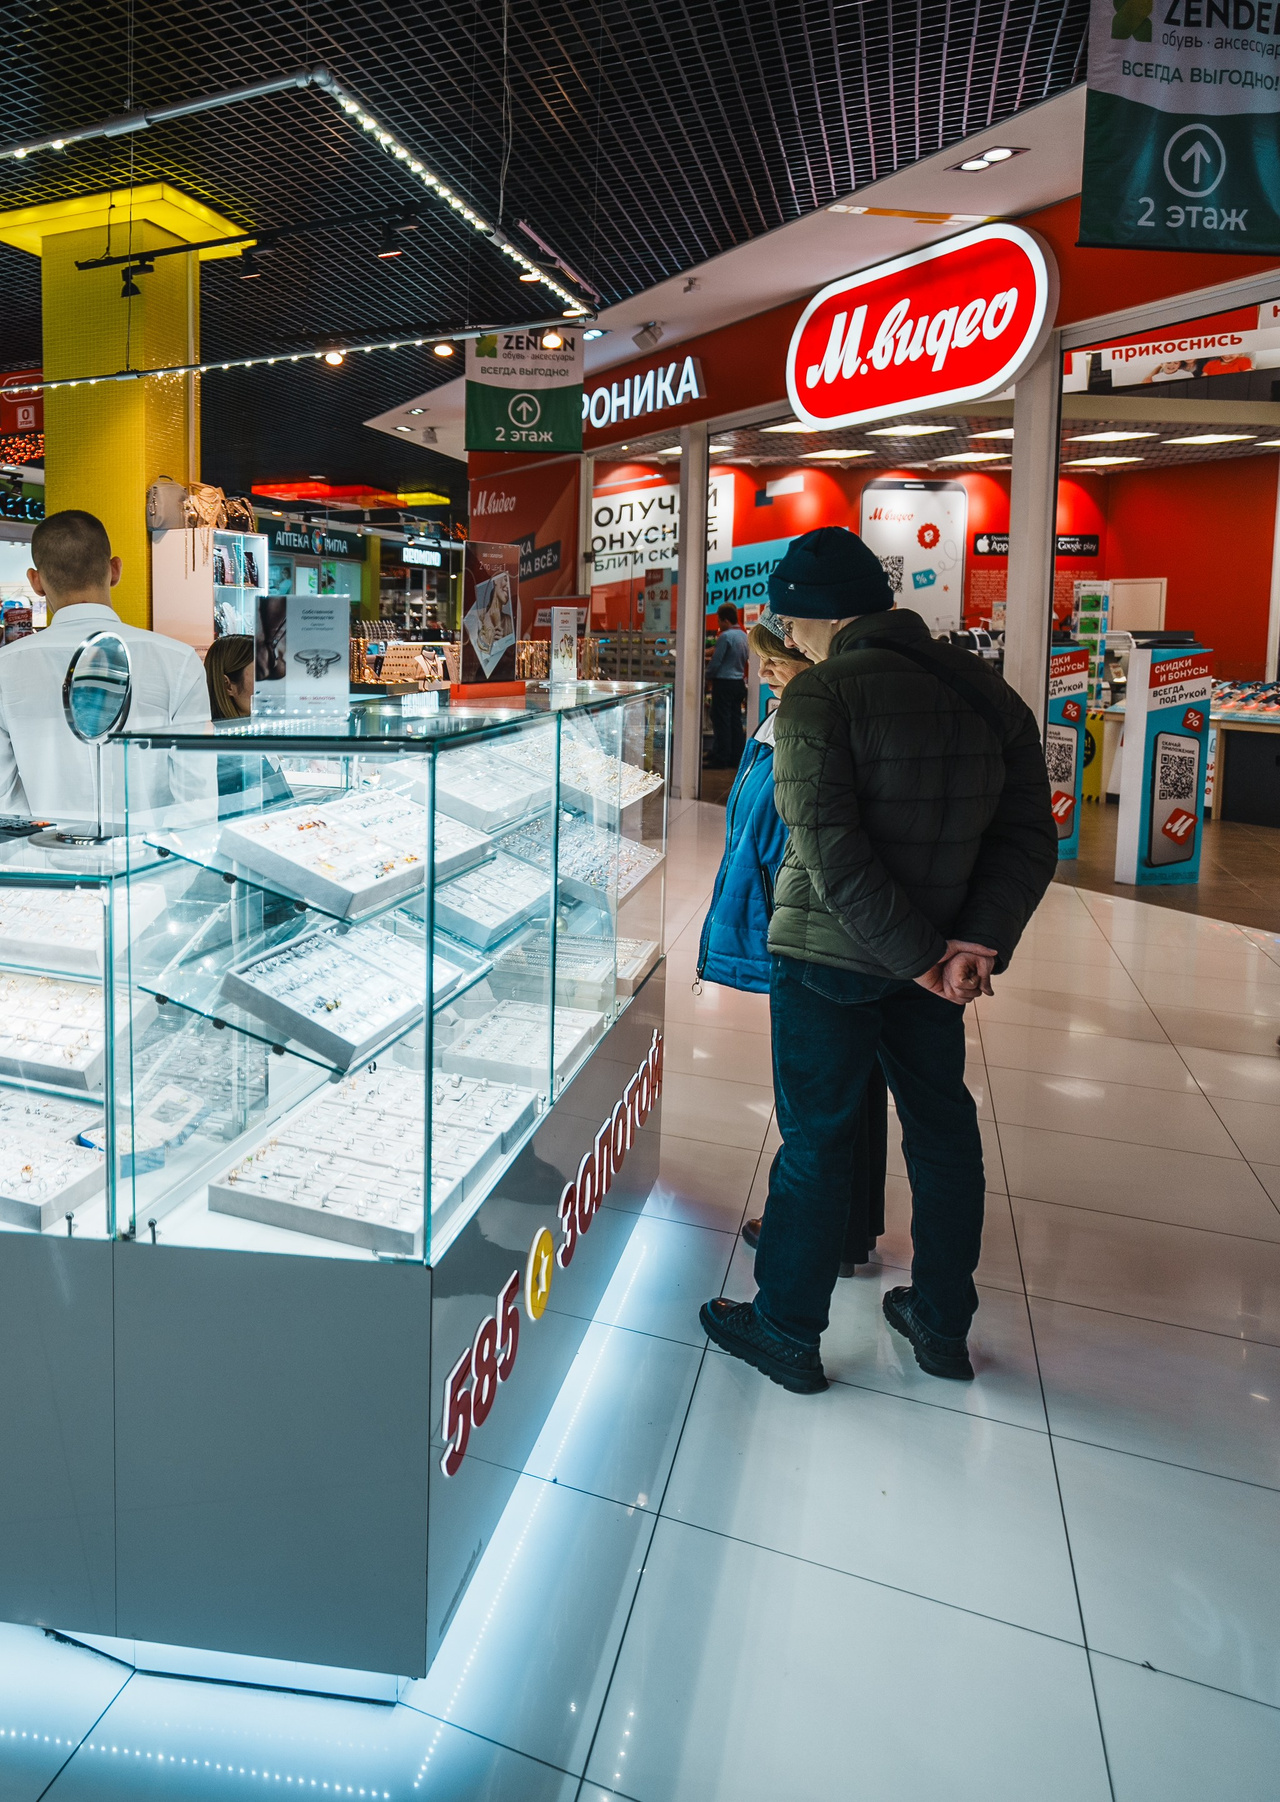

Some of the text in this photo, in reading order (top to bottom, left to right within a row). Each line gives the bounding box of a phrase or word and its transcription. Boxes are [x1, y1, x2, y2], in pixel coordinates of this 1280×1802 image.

[1162, 30, 1280, 59] обувь аксессуар
[1122, 60, 1280, 92] ВСЕГДА ВЫГОДНО!
[1136, 197, 1250, 232] 2 этаж
[503, 335, 575, 352] ZENN
[806, 287, 1019, 389] М.видео
[502, 351, 575, 361] обувь аксессуары
[1111, 334, 1243, 362] прикоснись
[481, 366, 569, 377] ВСЕГДА ВЫГОДНО!
[495, 427, 553, 443] 2 этаж
[275, 531, 310, 549] АПТЕКА
[1058, 541, 1097, 553] Google play
[714, 558, 783, 584] МОБИЛ
[706, 581, 769, 605] РИЛО
[1154, 659, 1192, 674] СКИДКИ
[1168, 665, 1208, 681] БОНУСЫ
[1057, 682, 1083, 694] РУКОЙ
[1153, 684, 1184, 698] ВСЕГДА
[1159, 687, 1207, 705] ПОД РУКОЙ
[1161, 745, 1195, 755] ПРИЛОЖЕНИЕ
[1162, 740, 1181, 748] СКАЧАЙ
[439, 1028, 664, 1477] 585 ЗОЛОТОЙ
